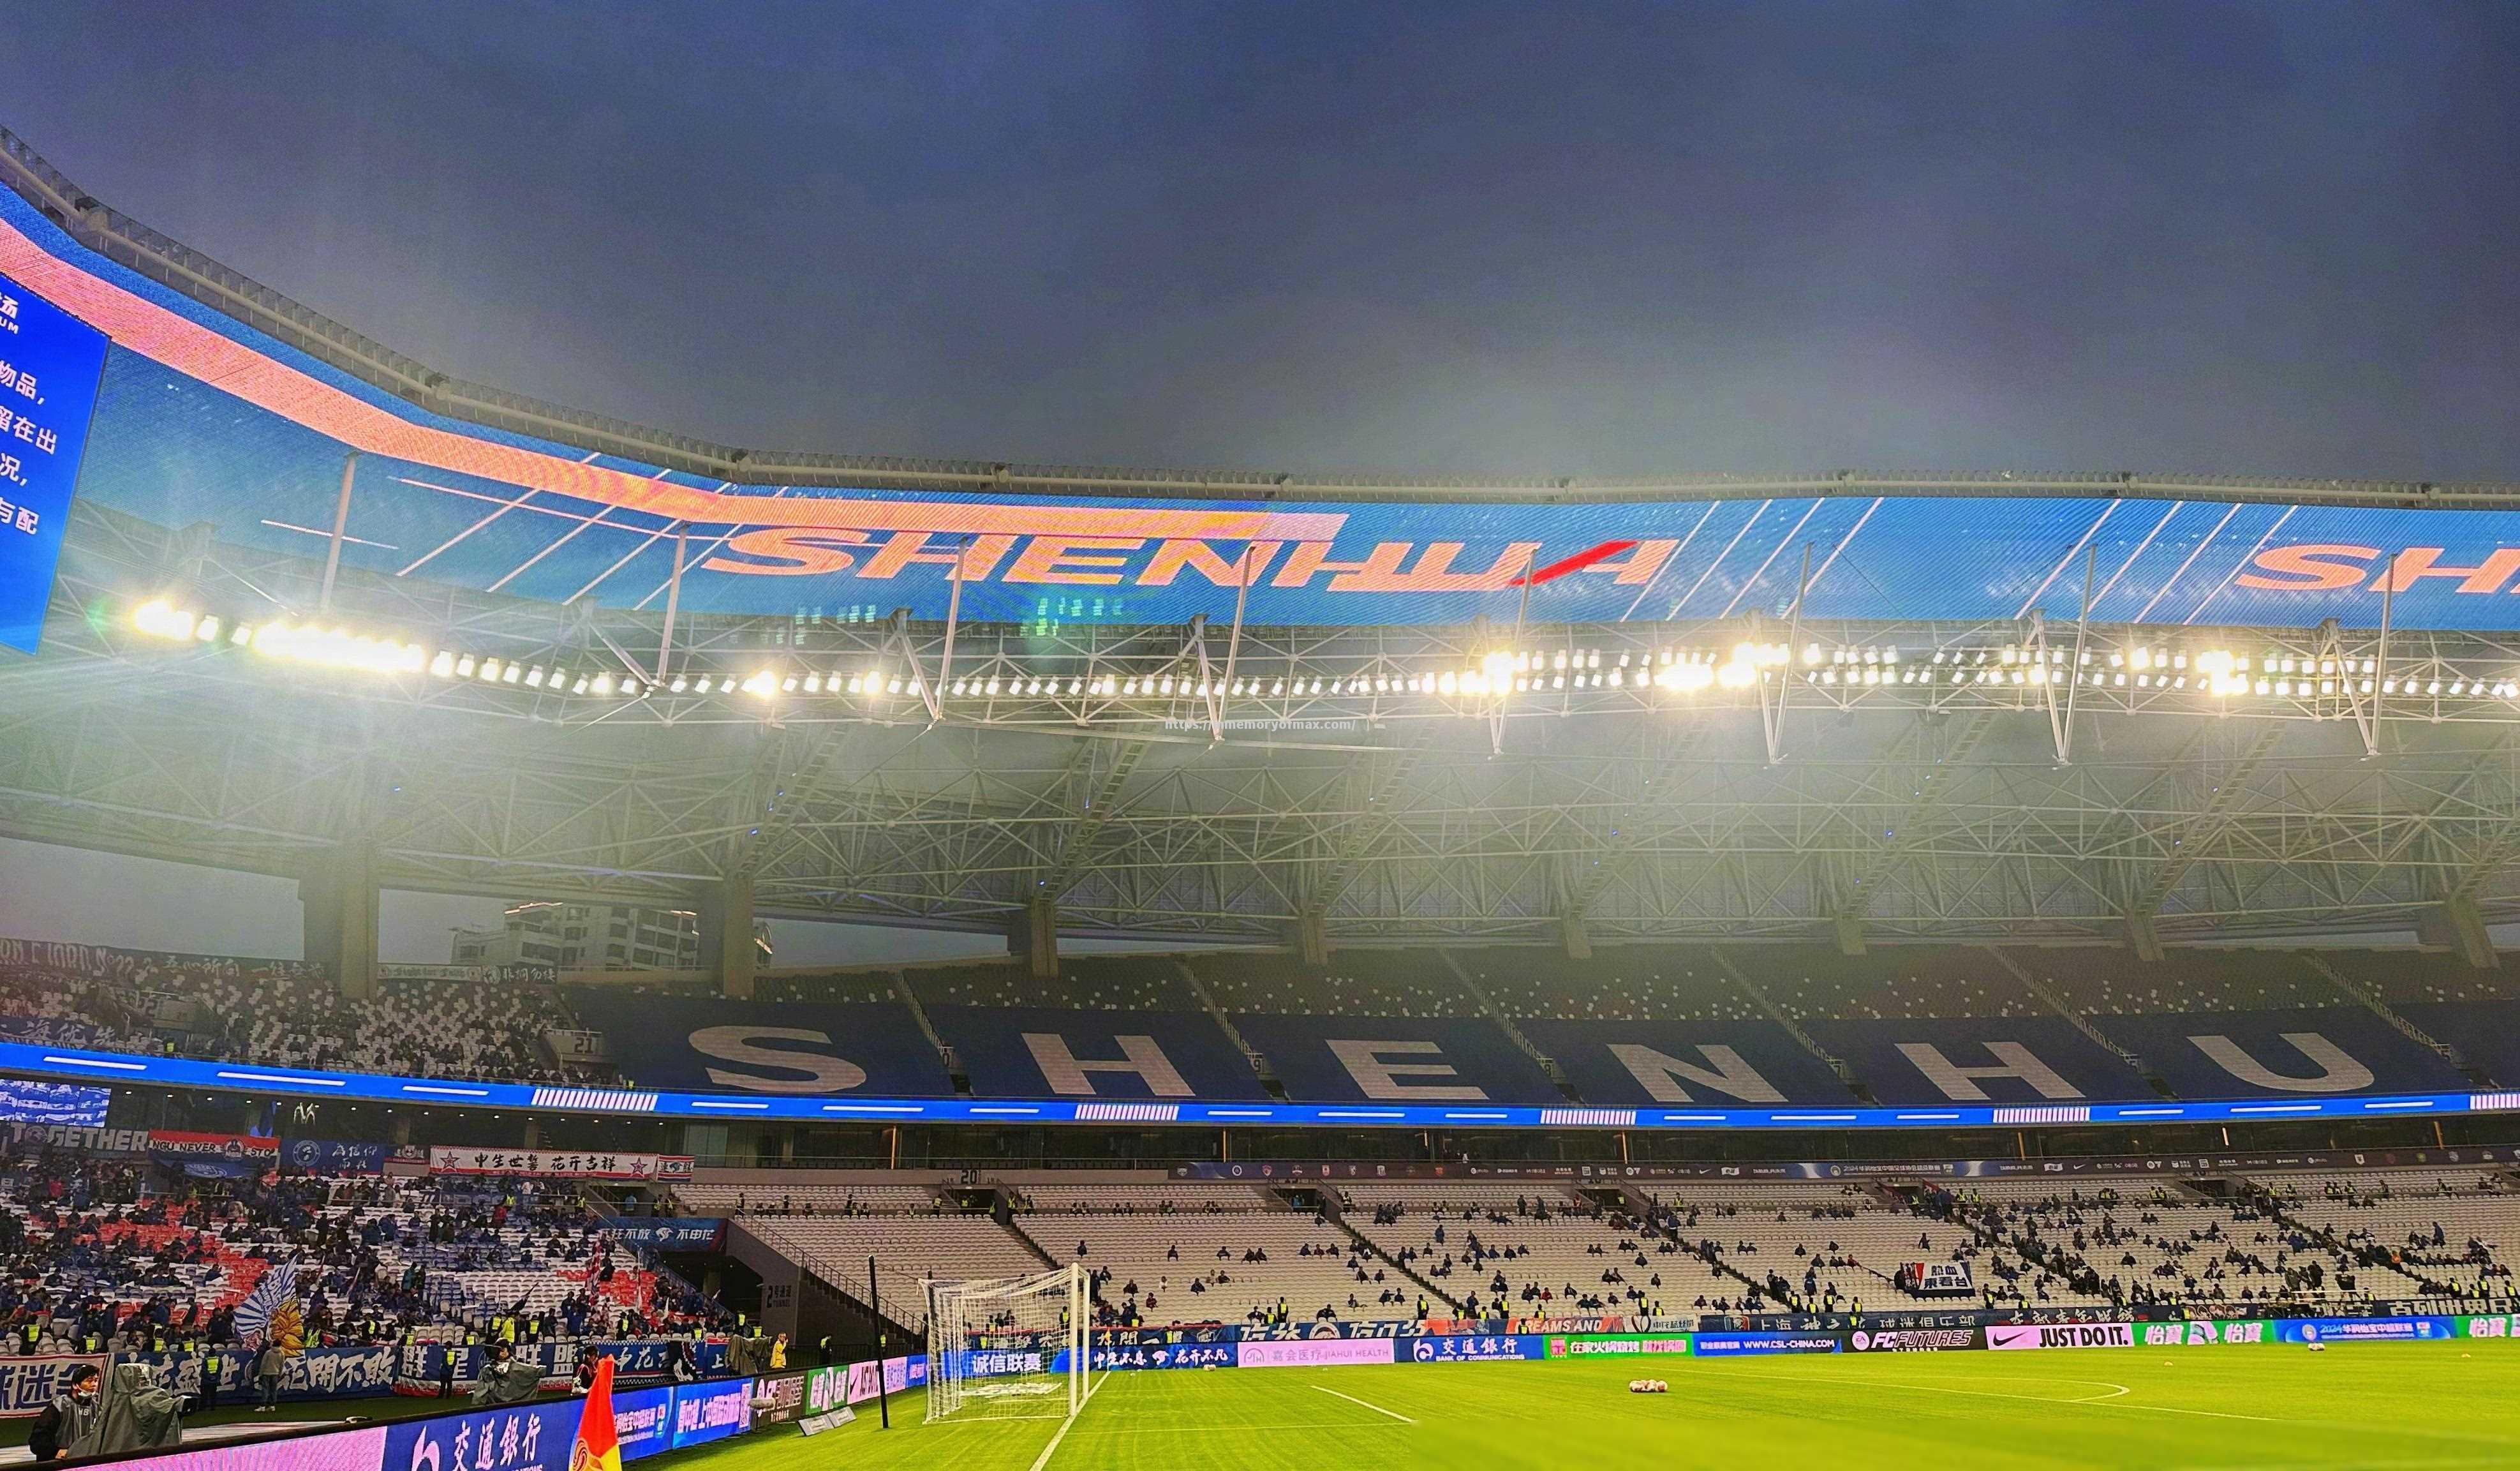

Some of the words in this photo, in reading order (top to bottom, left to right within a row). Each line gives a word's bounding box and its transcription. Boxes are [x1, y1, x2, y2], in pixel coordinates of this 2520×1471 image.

[702, 526, 1680, 592] SHENHUA
[2234, 544, 2520, 594] SH
[574, 1037, 594, 1053] 21
[179, 1142, 216, 1153] NEVER
[551, 1155, 616, 1172] 花开吉祥
[1515, 1318, 1573, 1334] REAMS
[1575, 1318, 1603, 1332] AND
[1743, 1339, 1835, 1349] WWW.CSL-CHINA.COM
[2039, 1327, 2077, 1347] JUST
[2080, 1327, 2105, 1347] DO
[2108, 1326, 2129, 1345] IT.
[1324, 1348, 1353, 1360] JIAHUI
[1356, 1348, 1389, 1358] HEALTH
[1442, 1337, 1518, 1355] 交通銀行
[972, 1352, 1042, 1373] 诚信联赛
[452, 1412, 542, 1471] 交通銀行
